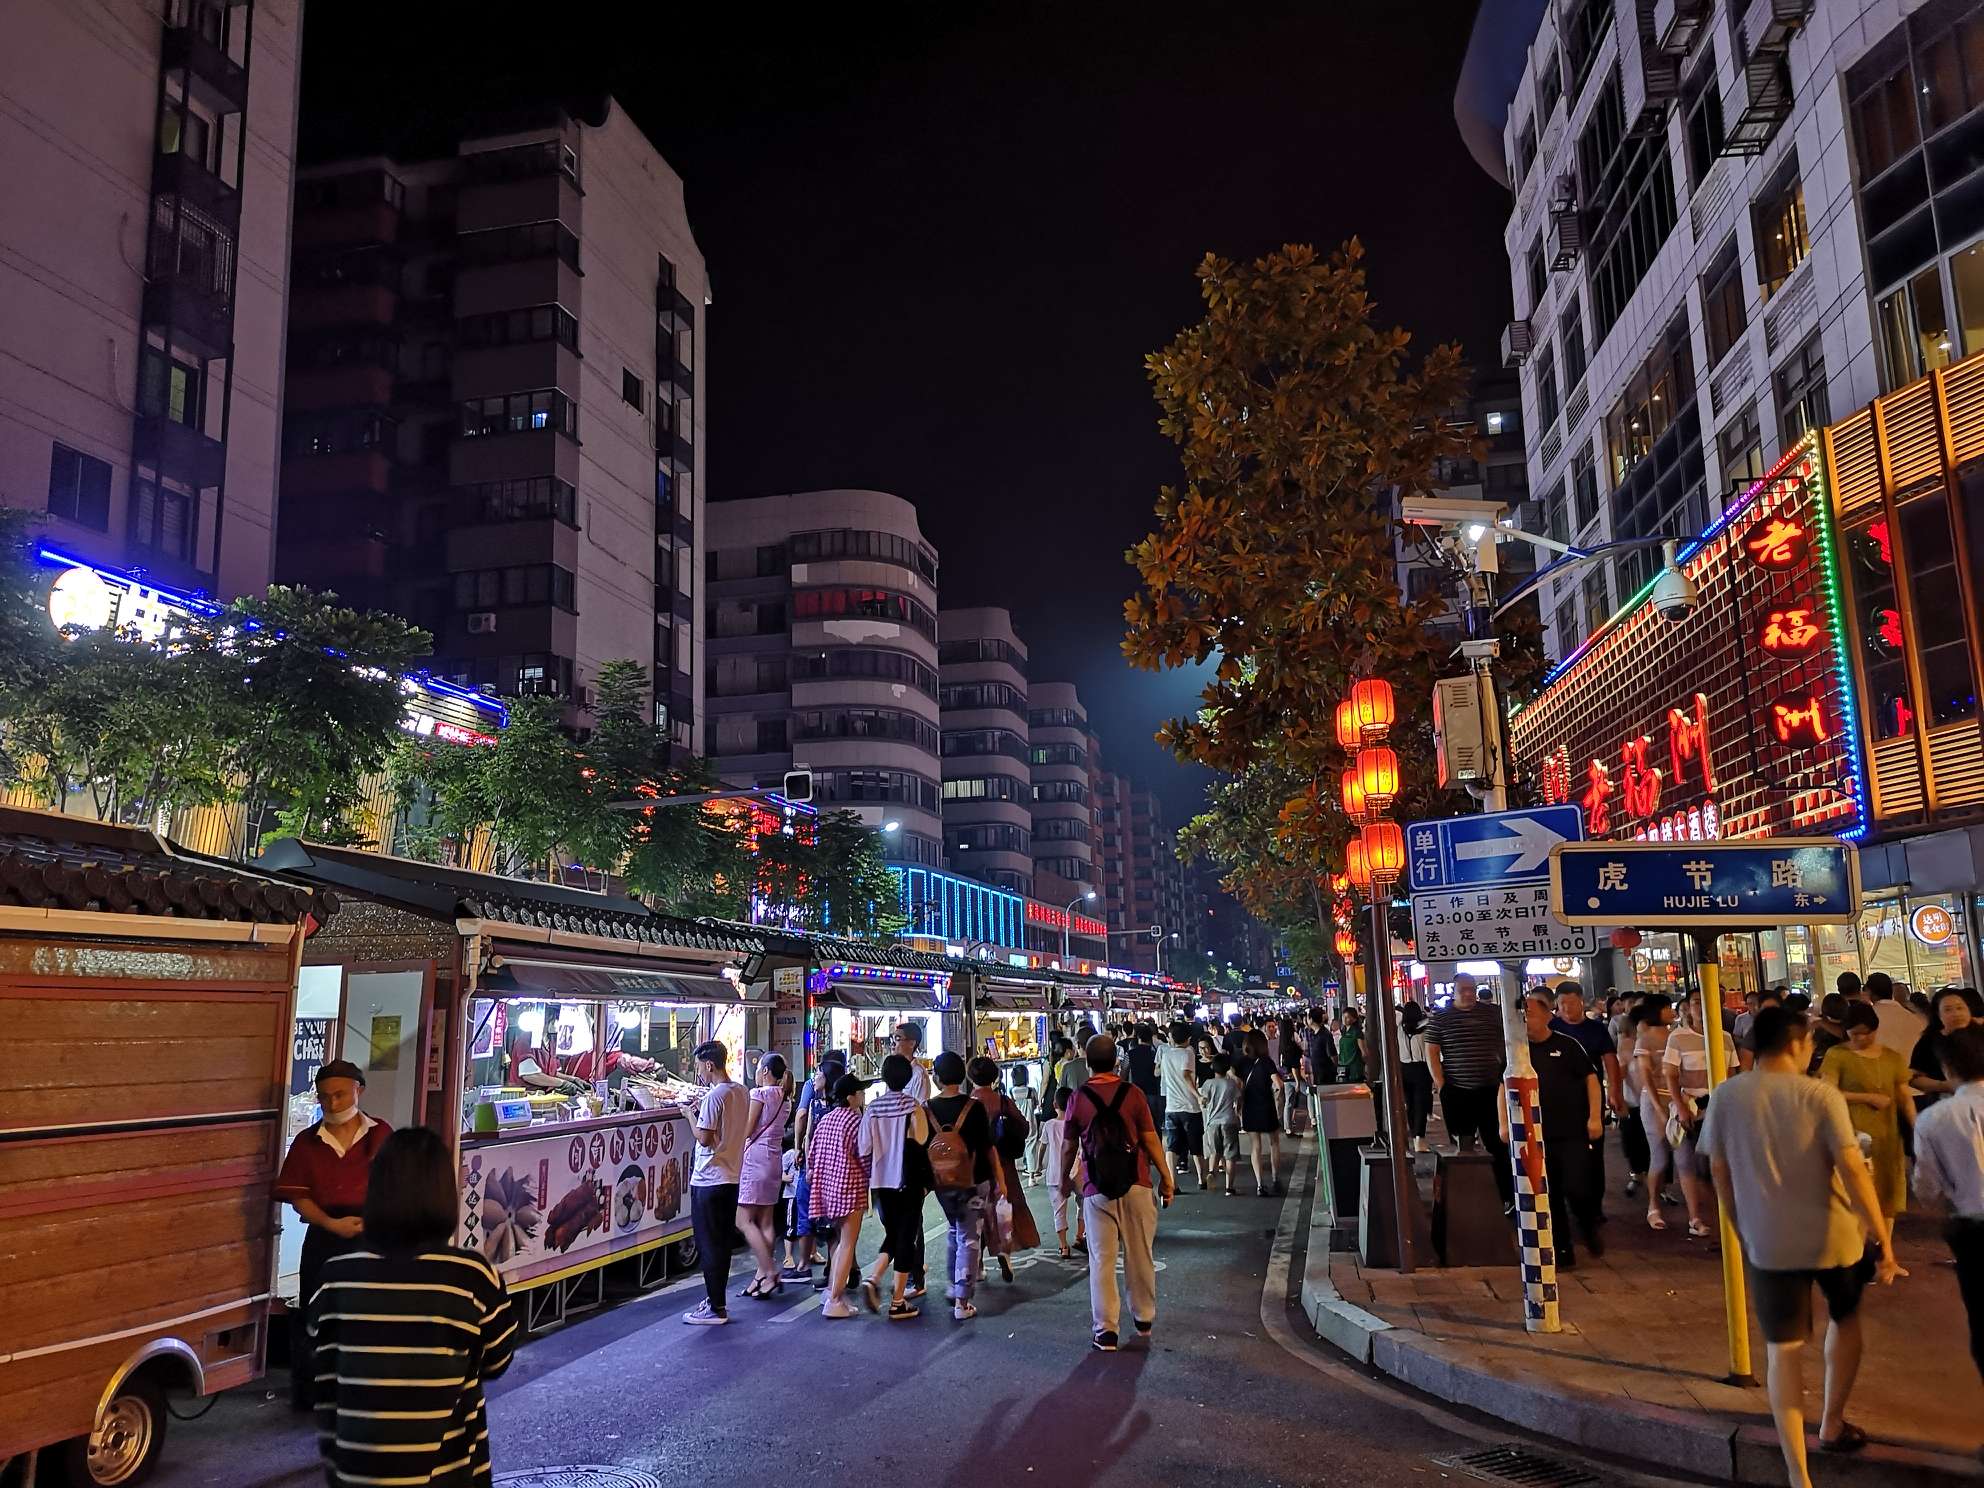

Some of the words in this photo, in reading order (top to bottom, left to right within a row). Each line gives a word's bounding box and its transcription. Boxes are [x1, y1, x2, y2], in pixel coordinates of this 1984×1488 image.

[1414, 830, 1438, 881] 单行
[1597, 860, 1803, 892] 虎节路
[1422, 889, 1548, 910] 工作日及周
[1664, 895, 1710, 908] HUJIE
[1717, 895, 1739, 907] LU
[1794, 892, 1810, 908] 东
[1426, 924, 1585, 943] 法定节假日
[1427, 937, 1586, 958] 23:00至次日11:00
